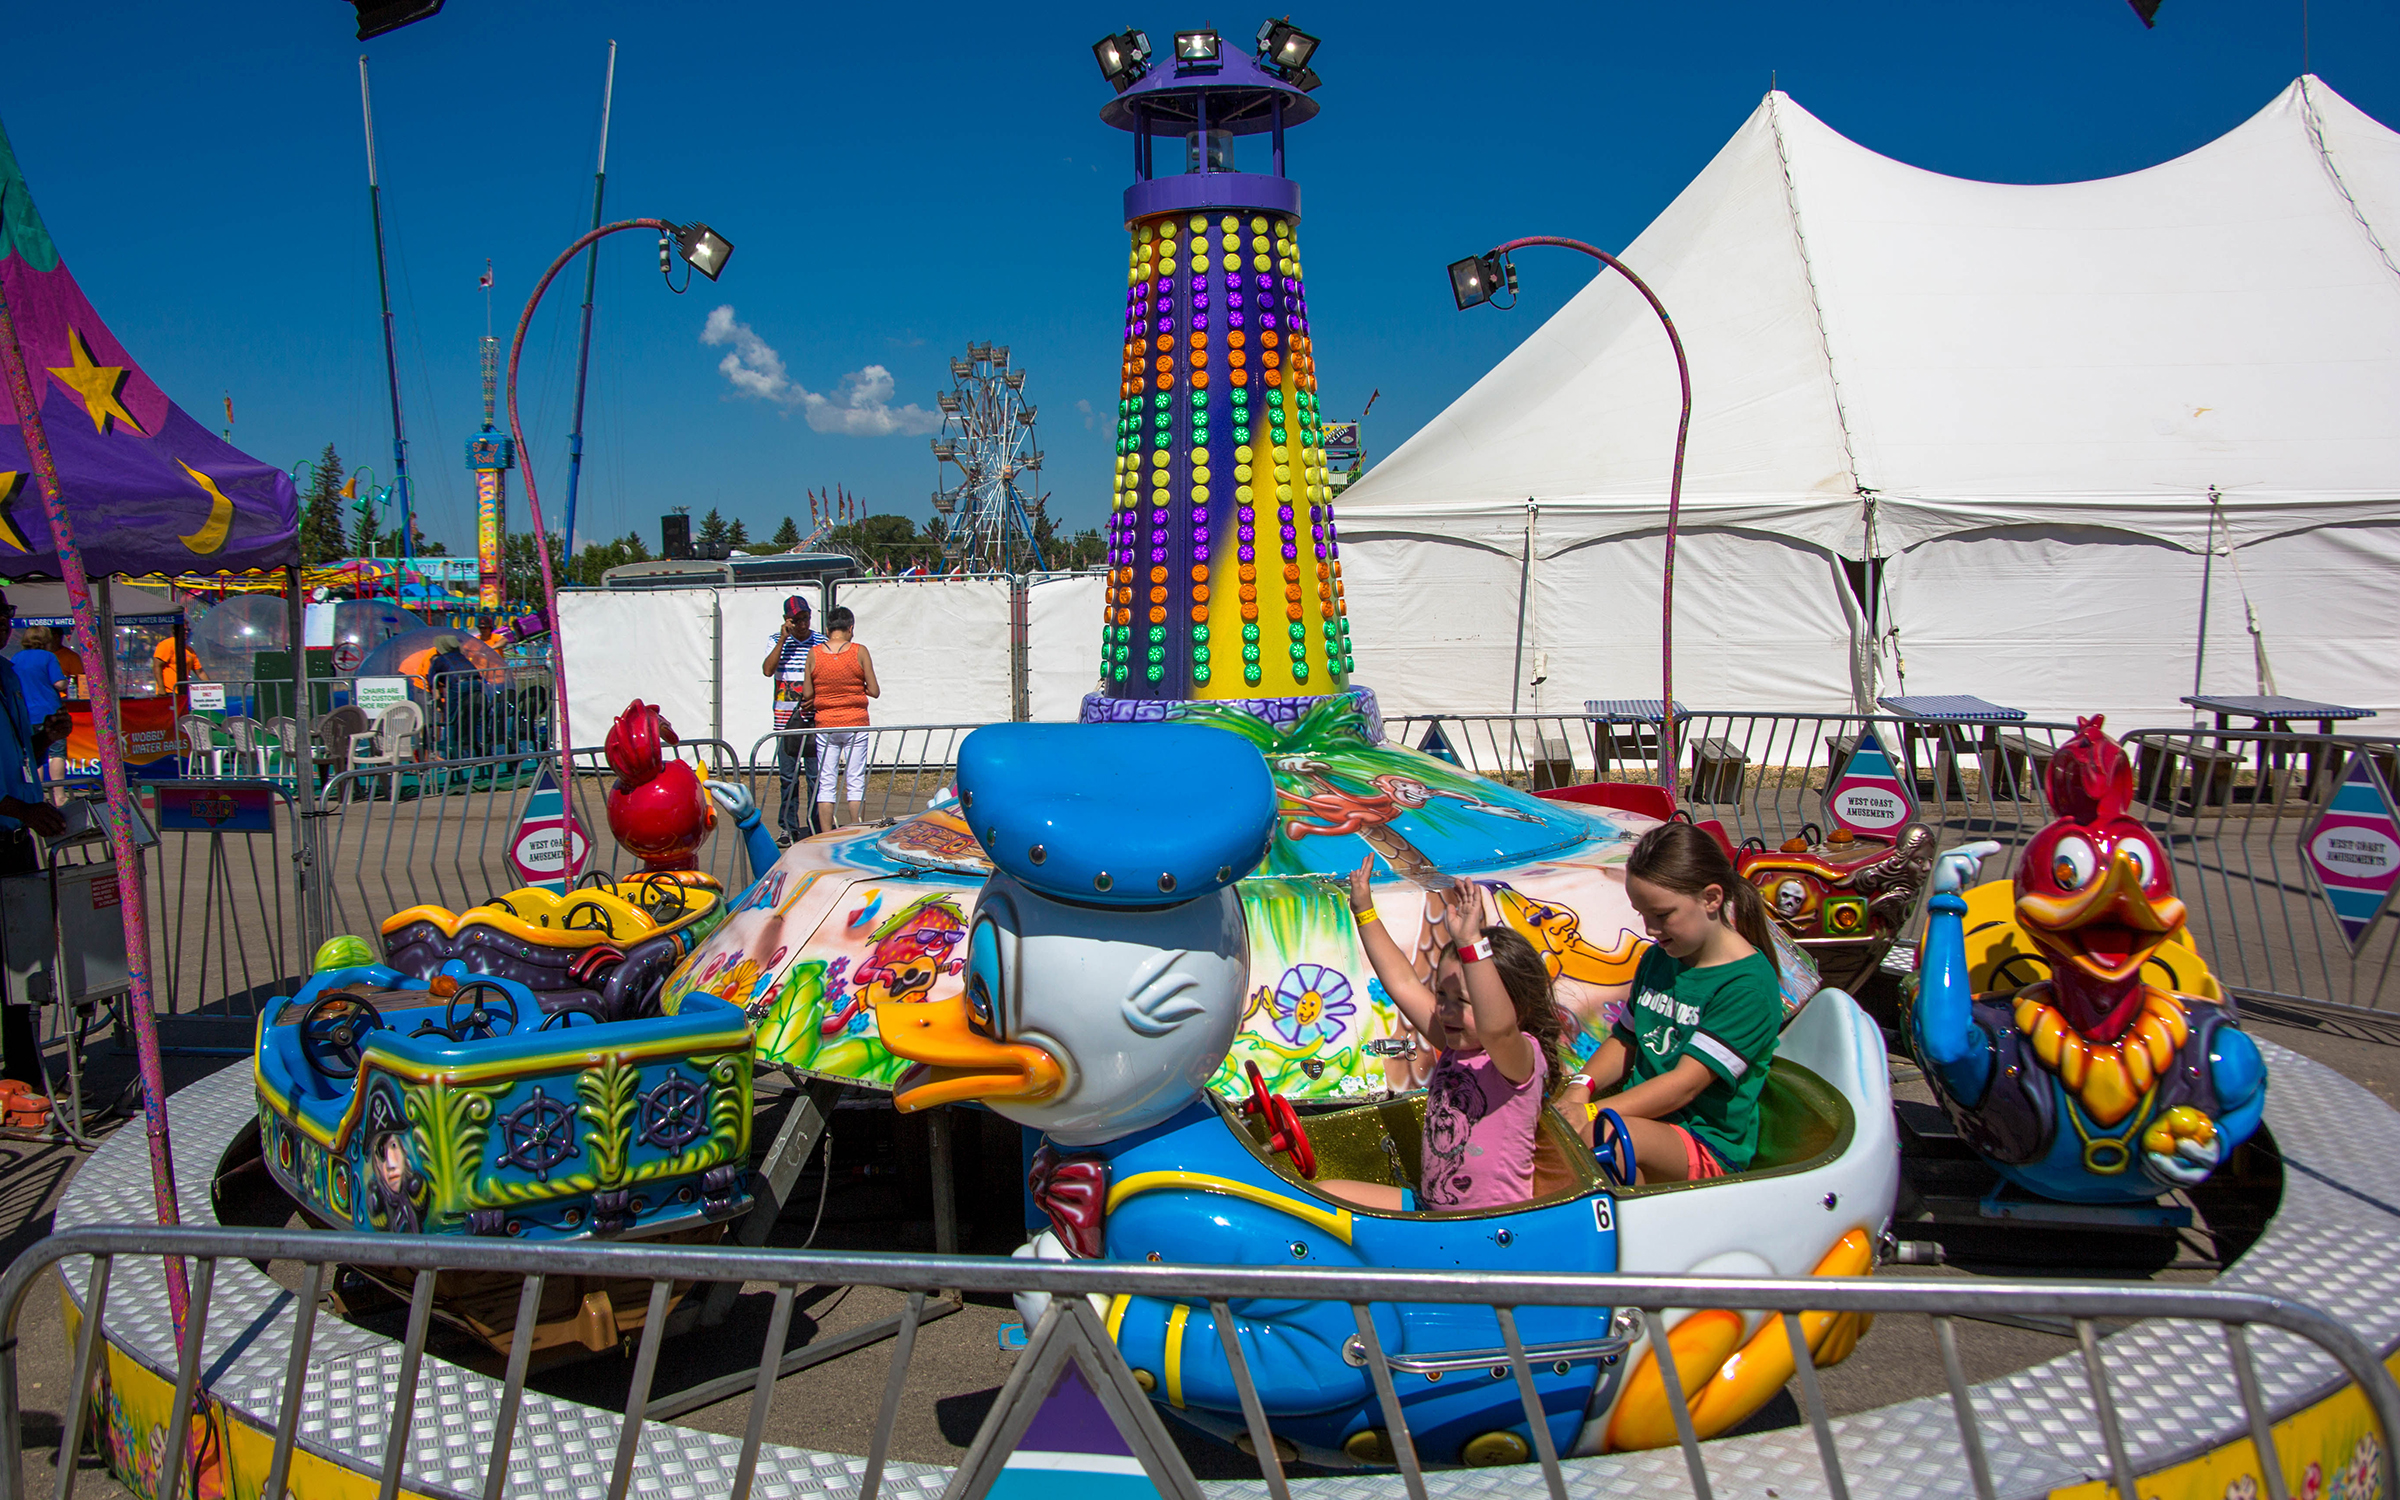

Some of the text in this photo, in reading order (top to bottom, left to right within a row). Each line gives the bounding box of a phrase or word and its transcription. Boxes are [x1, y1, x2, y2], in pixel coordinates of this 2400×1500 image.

[1329, 427, 1350, 444] SLIDE
[116, 617, 138, 625] WOBBLY
[139, 616, 157, 624] WATER
[131, 730, 166, 743] WOBBLY
[132, 742, 162, 754] WATER
[191, 800, 239, 817] EXIT
[1848, 797, 1894, 808] WEST COAST
[1846, 808, 1895, 819] AMUSEMENTS
[529, 840, 548, 850] WEST
[2328, 838, 2386, 853] WEST COAST
[529, 850, 573, 863] AMUSEMEN
[2326, 851, 2387, 866] AMUSEMENTS
[1596, 1200, 1610, 1229] 6
